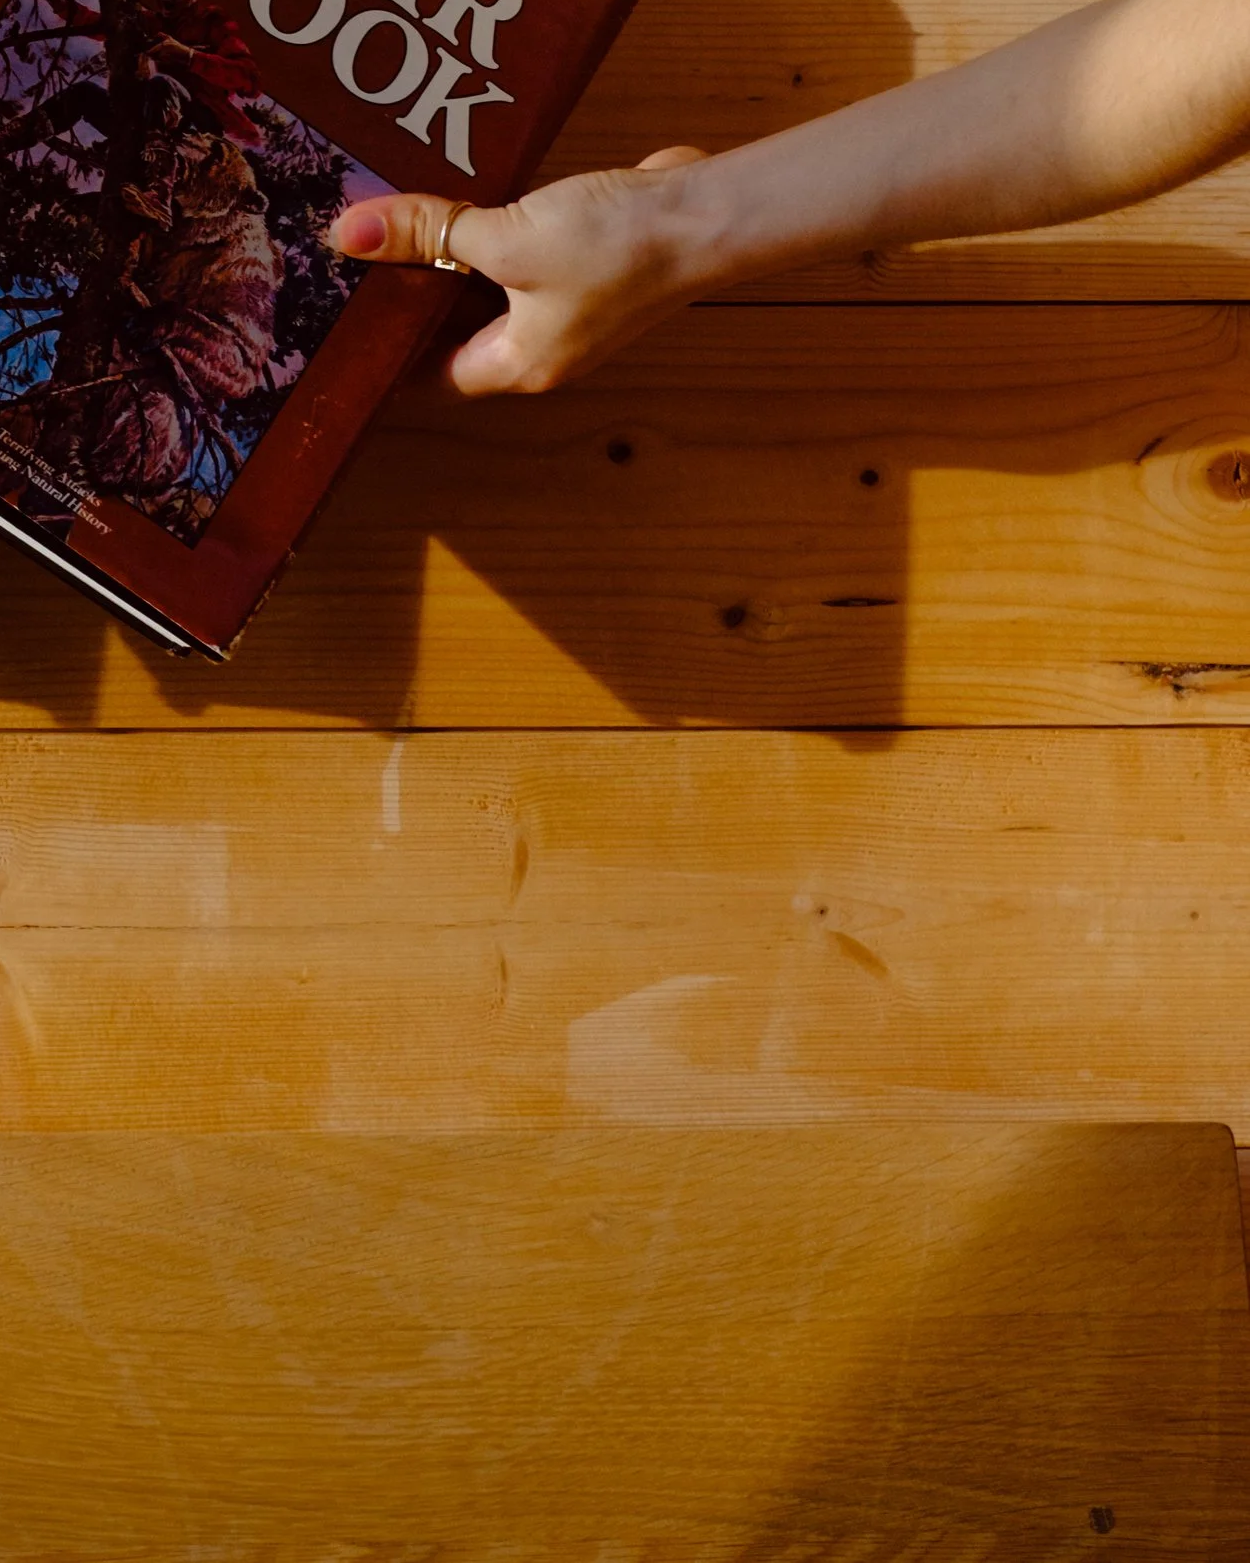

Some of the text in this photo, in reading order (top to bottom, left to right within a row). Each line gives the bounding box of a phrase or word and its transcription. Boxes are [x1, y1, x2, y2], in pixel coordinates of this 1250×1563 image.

[18, 464, 72, 504] Natural
[66, 497, 114, 536] History
[55, 471, 104, 509] Attacks
